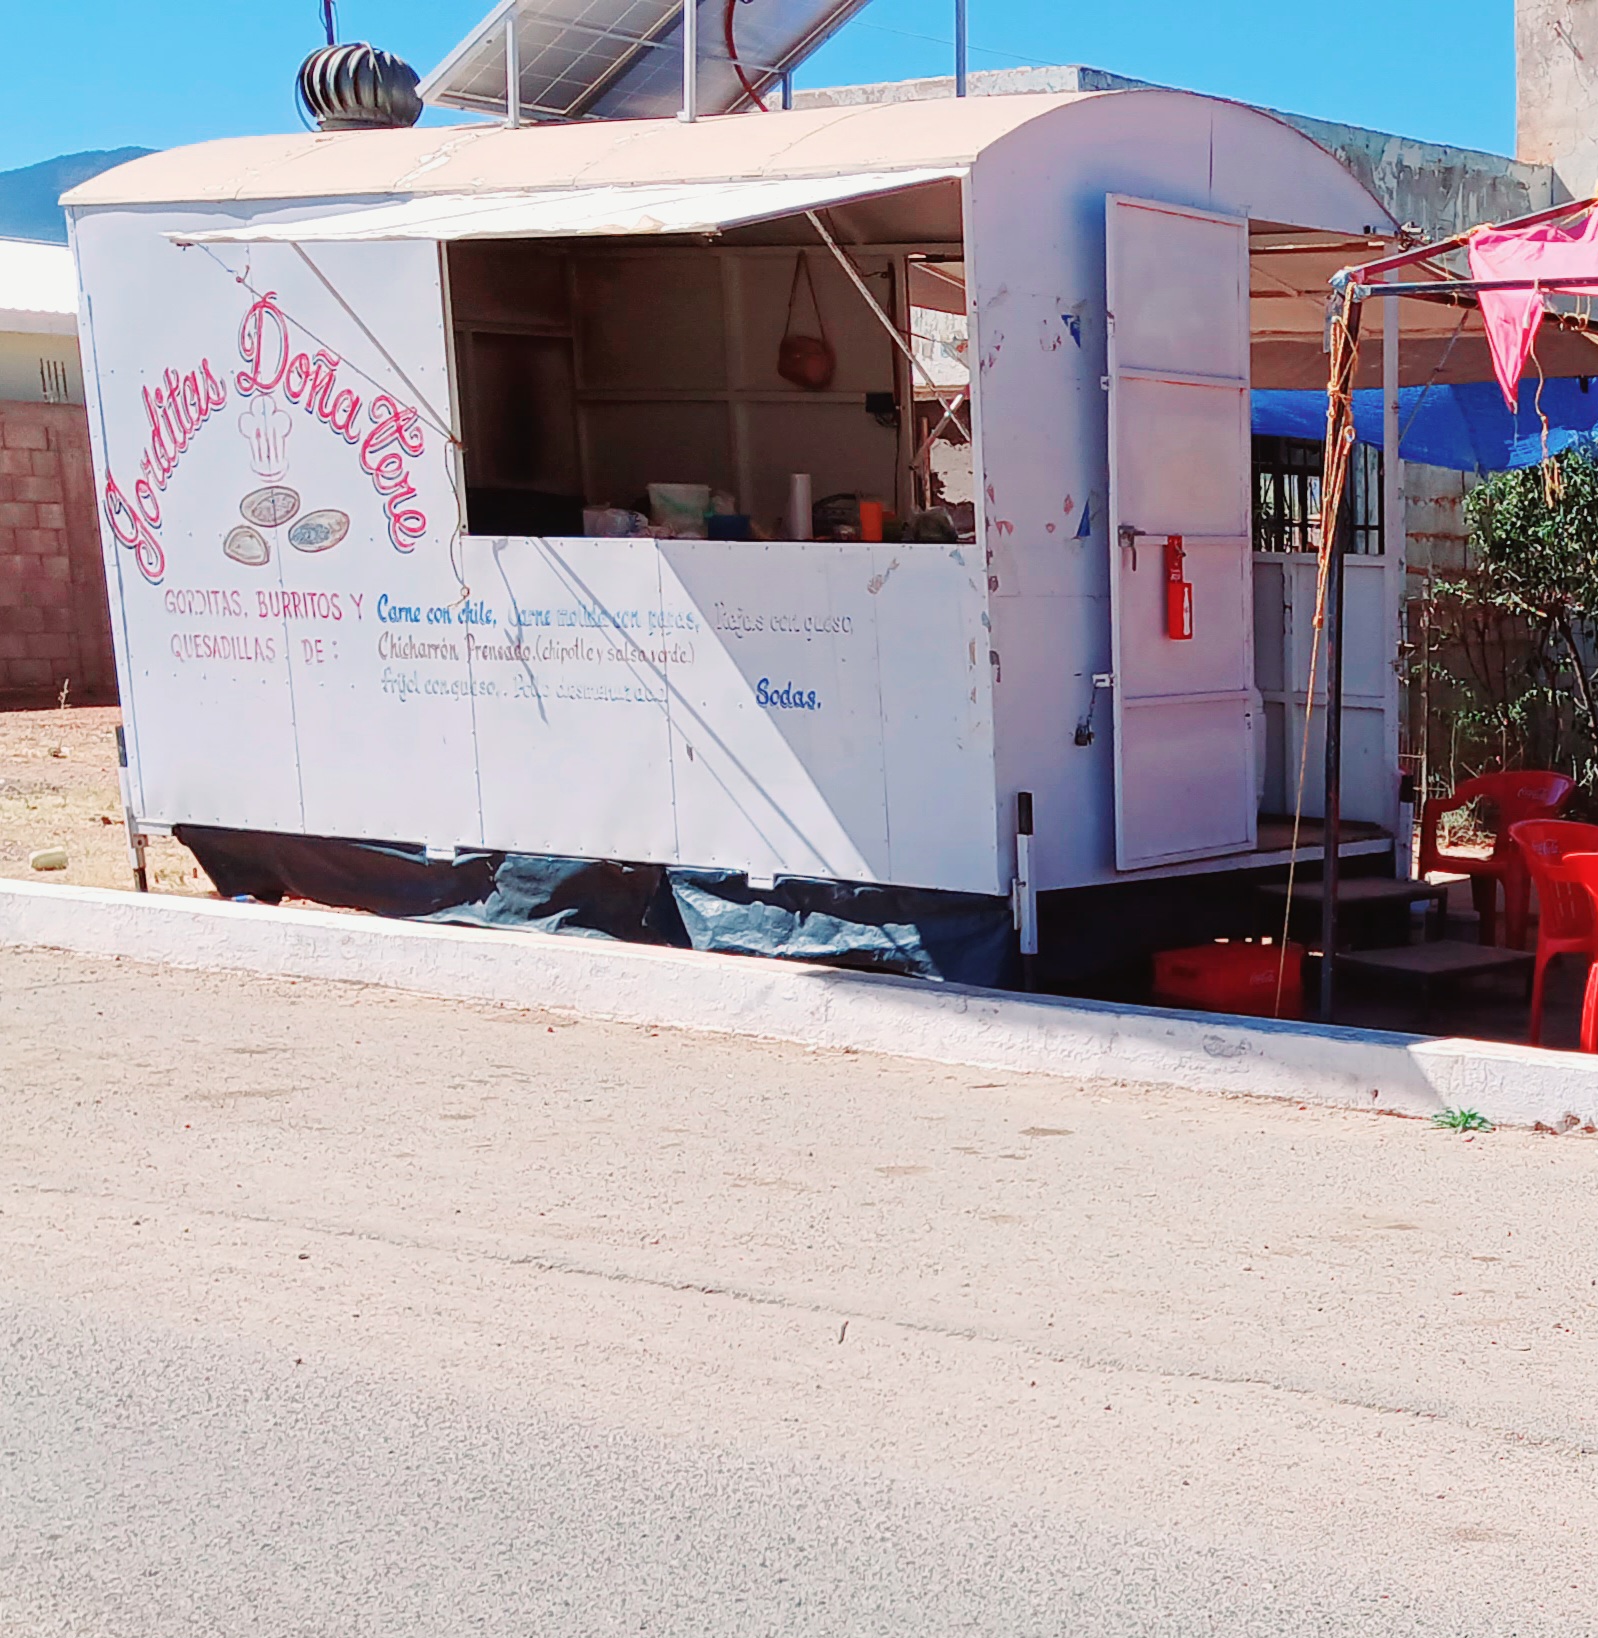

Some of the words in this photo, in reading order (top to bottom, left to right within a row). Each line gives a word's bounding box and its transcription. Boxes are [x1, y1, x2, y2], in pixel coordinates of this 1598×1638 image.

[235, 290, 363, 445] Doña
[255, 590, 343, 621] BURRITOS
[349, 592, 364, 621] Y
[376, 593, 421, 624] Carne
[426, 606, 453, 625] con
[170, 633, 276, 664] QUESADILLAS
[377, 630, 460, 661] Chicharrón
[607, 641, 649, 663] salsa
